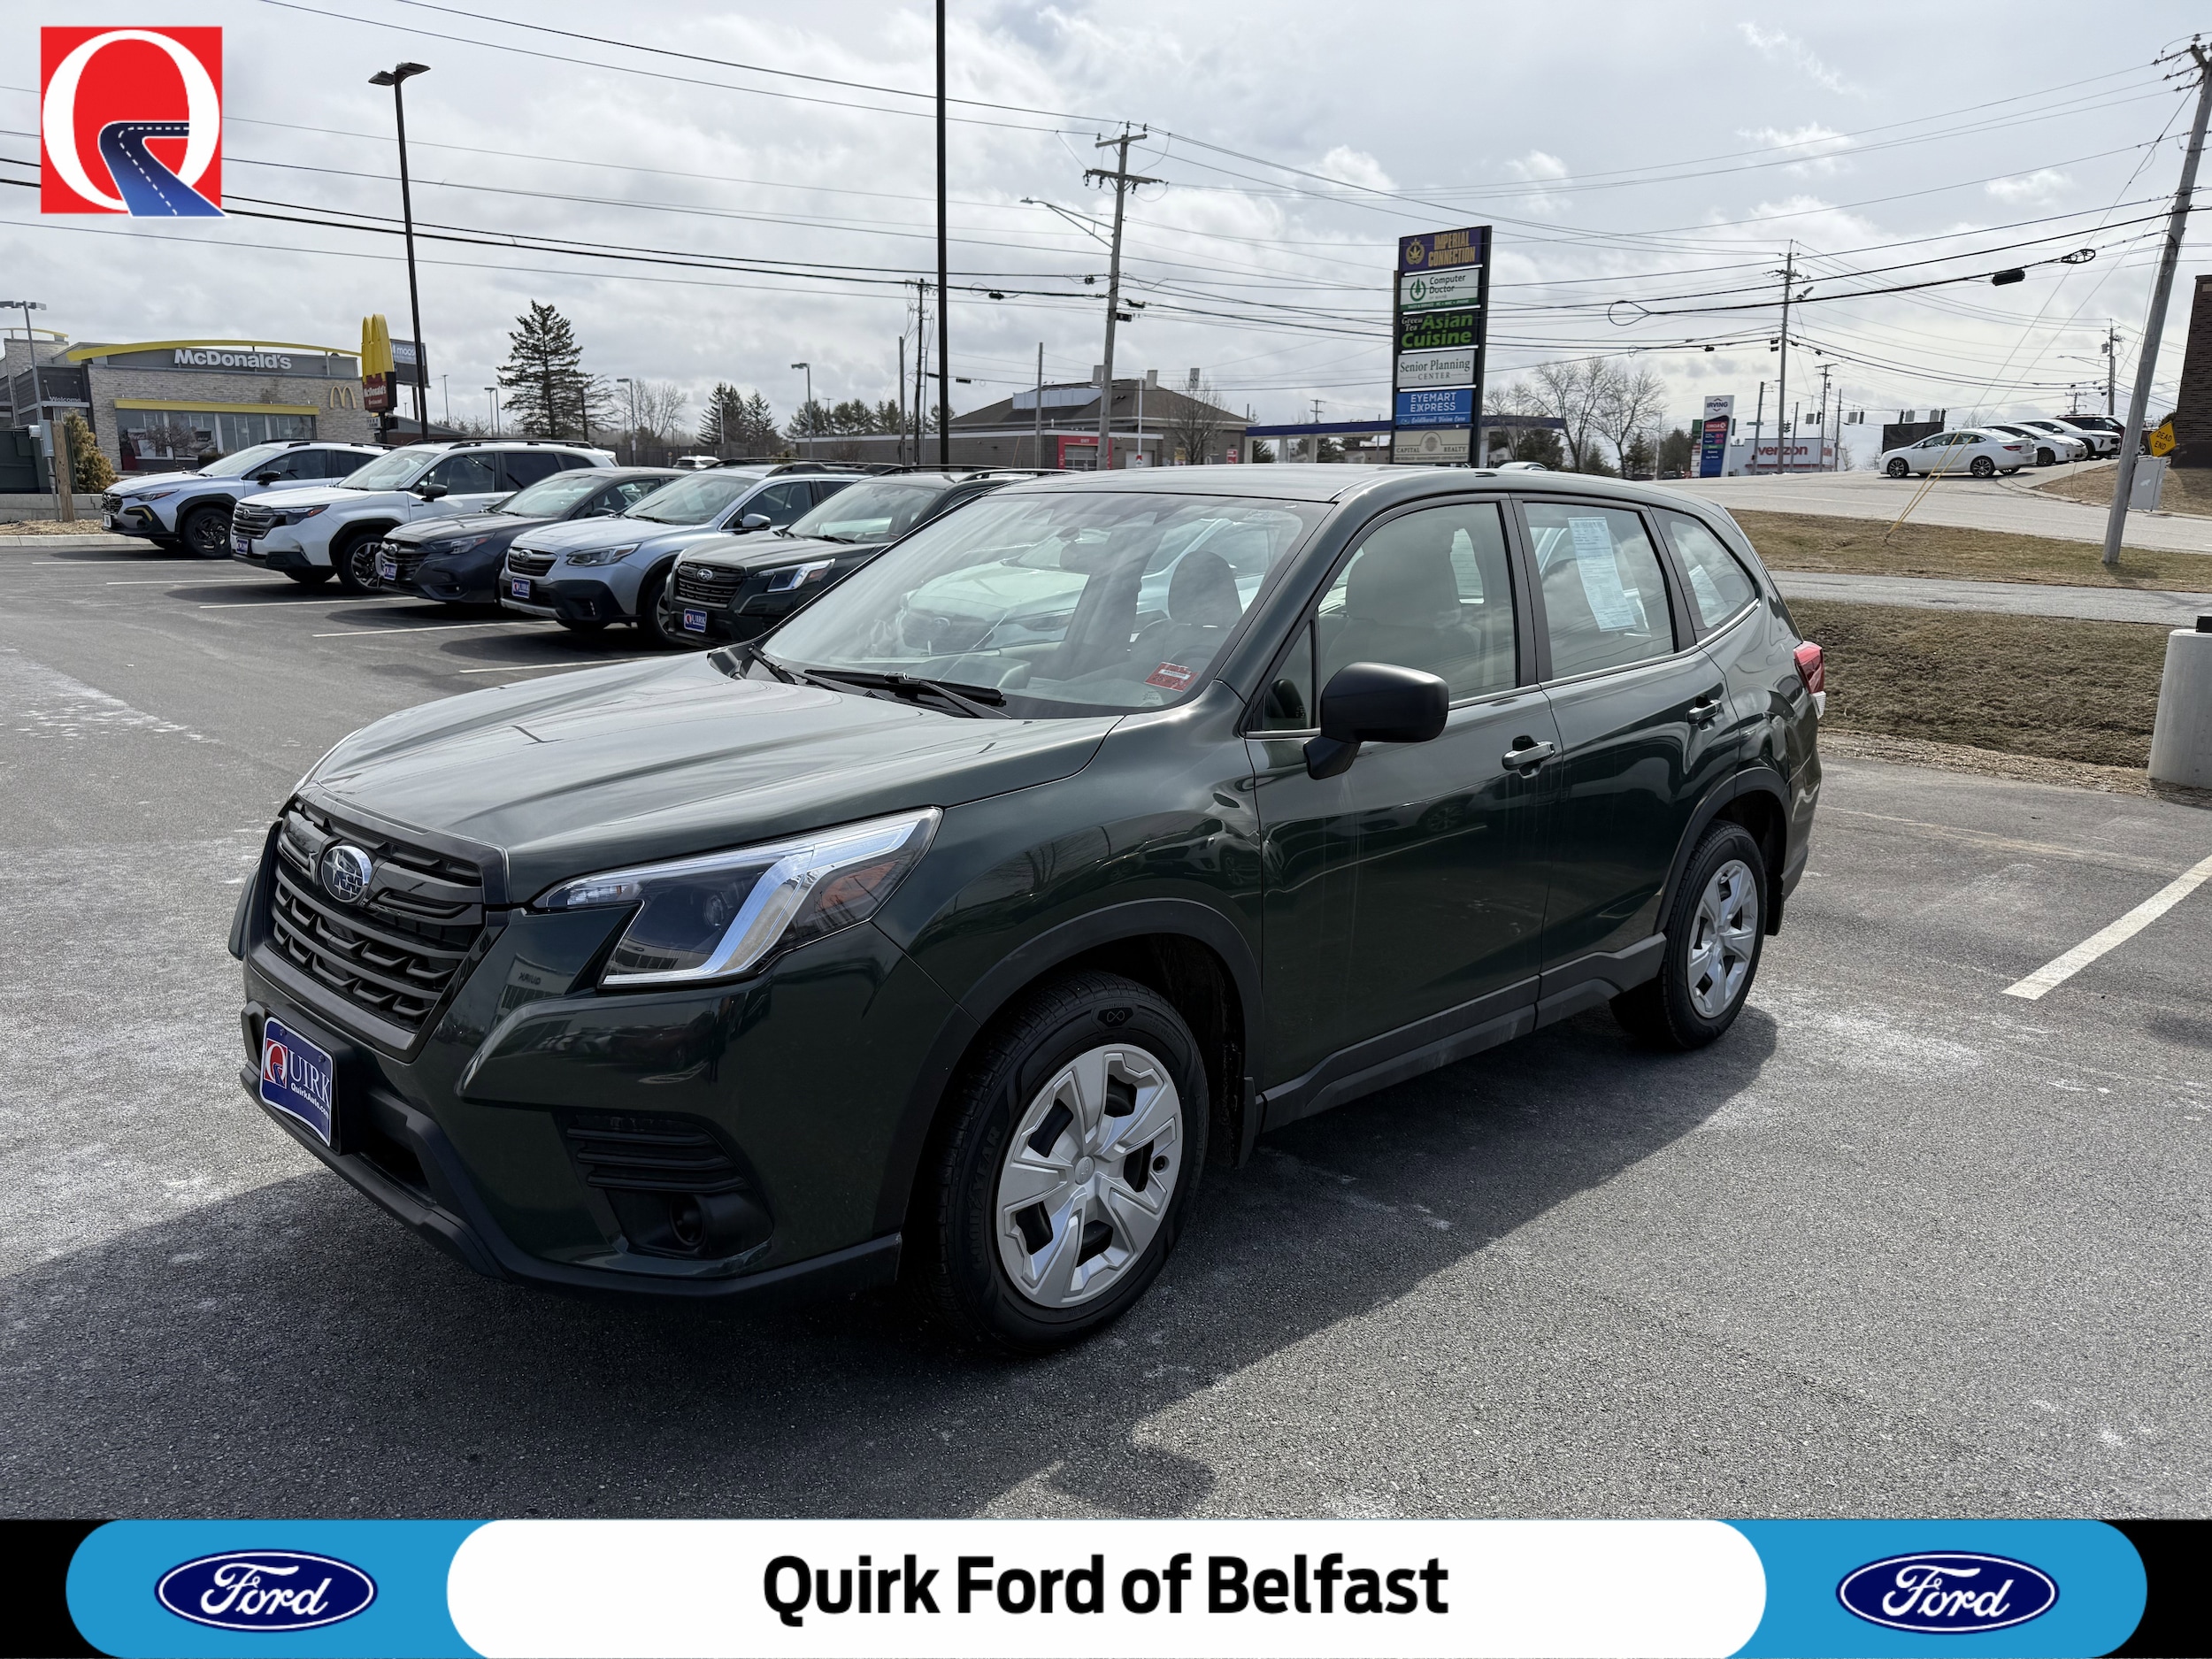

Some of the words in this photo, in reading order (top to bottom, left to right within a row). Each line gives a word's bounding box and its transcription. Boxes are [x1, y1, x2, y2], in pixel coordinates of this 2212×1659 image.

[1434, 231, 1470, 250] IMPERIAL
[1428, 246, 1476, 267] CONNECTION
[1429, 274, 1466, 286] Computer
[1429, 285, 1455, 295] Doctor
[1420, 313, 1473, 330] Asian
[1402, 330, 1472, 348] Cuisine
[174, 349, 292, 370] McDonald's
[1400, 361, 1428, 373] Senior
[1430, 358, 1471, 373] Planning
[1417, 372, 1451, 380] CENTER
[364, 384, 387, 398] McDonald's
[1410, 392, 1456, 403] EYEMART
[1410, 402, 1455, 412] EXPRESS
[2156, 431, 2172, 442] DEAD
[1758, 445, 1809, 455] verzon
[2154, 441, 2166, 449] END
[290, 1082, 330, 1119] QuirkAuto.com
